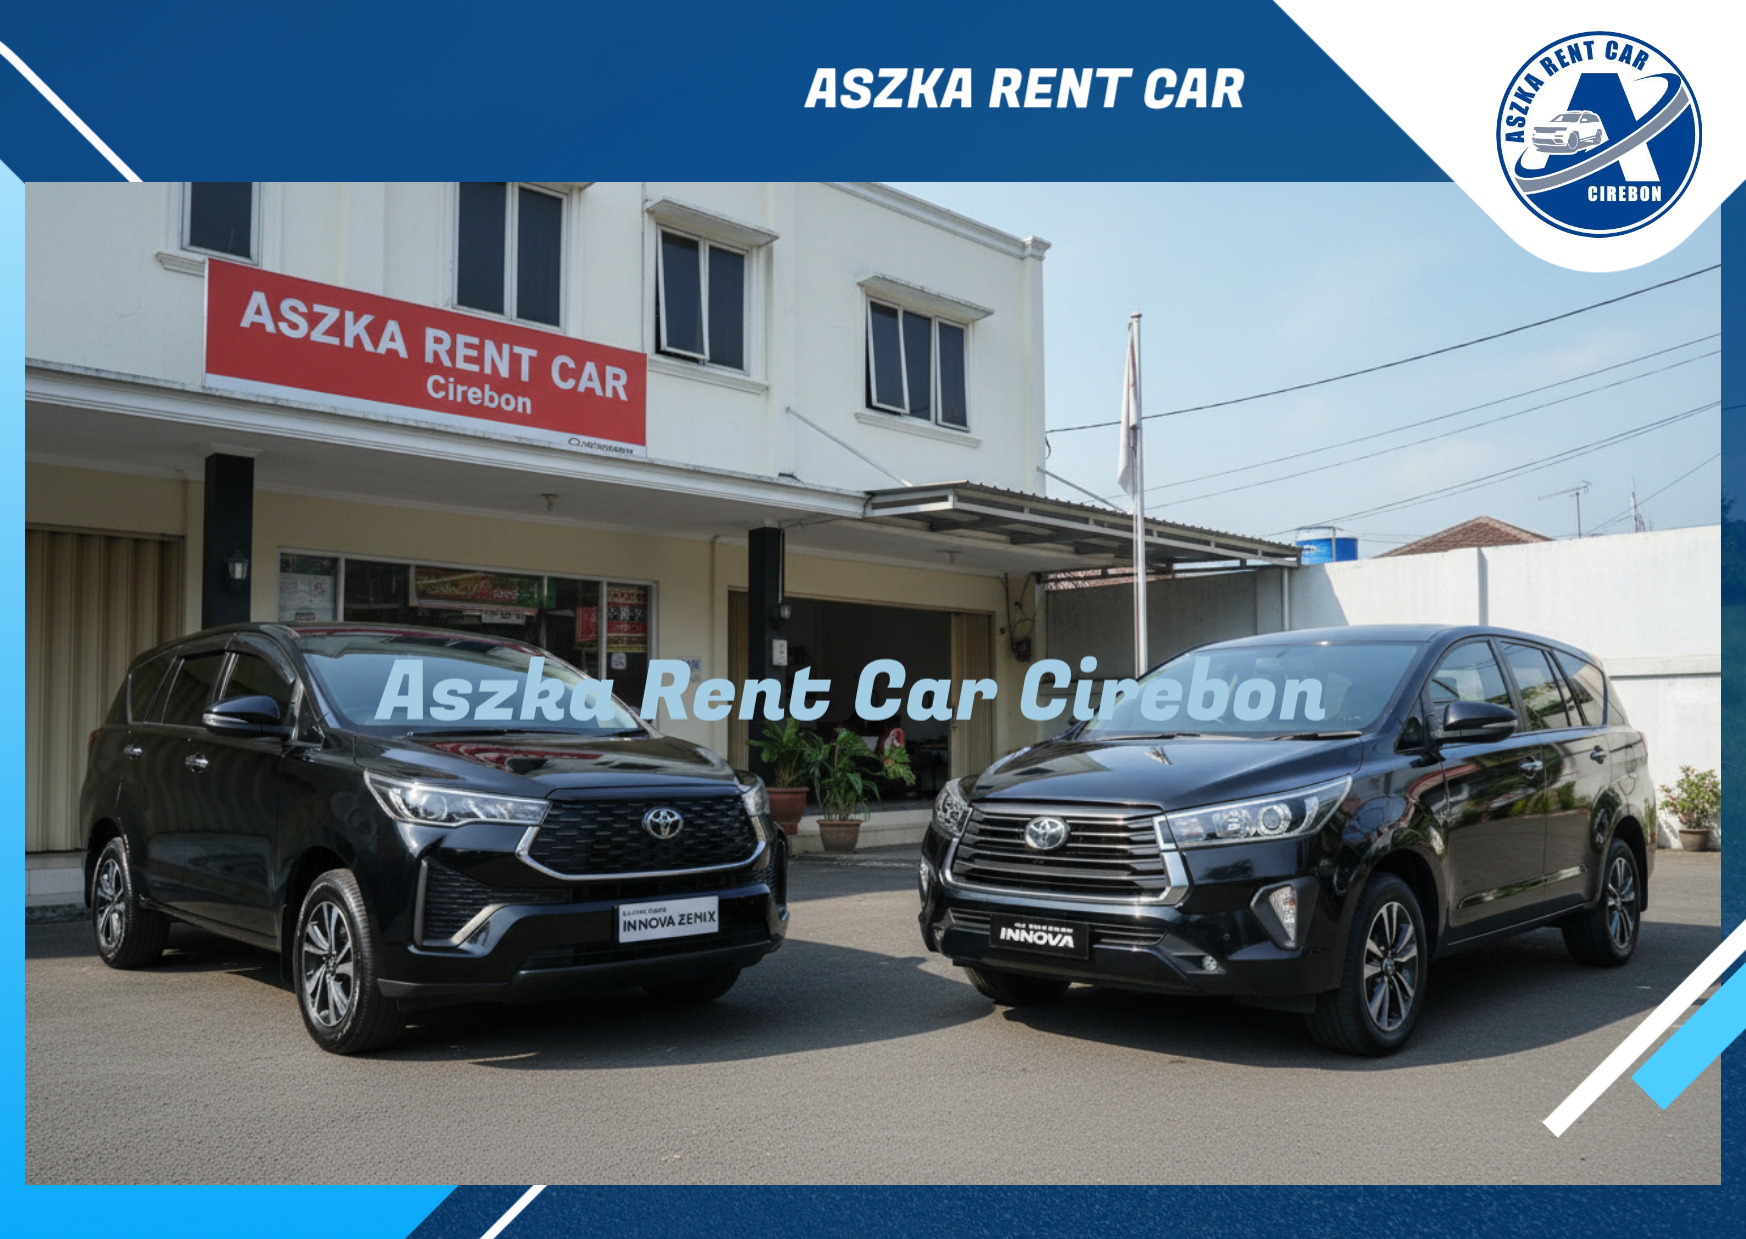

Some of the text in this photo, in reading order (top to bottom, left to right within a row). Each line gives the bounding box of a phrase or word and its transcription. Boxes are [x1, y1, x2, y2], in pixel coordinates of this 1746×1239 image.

[240, 290, 629, 402] ASZKA RENT CAR
[426, 374, 532, 415] Cirebon
[622, 915, 676, 933] INNOVA
[999, 926, 1075, 949] INNOVA
